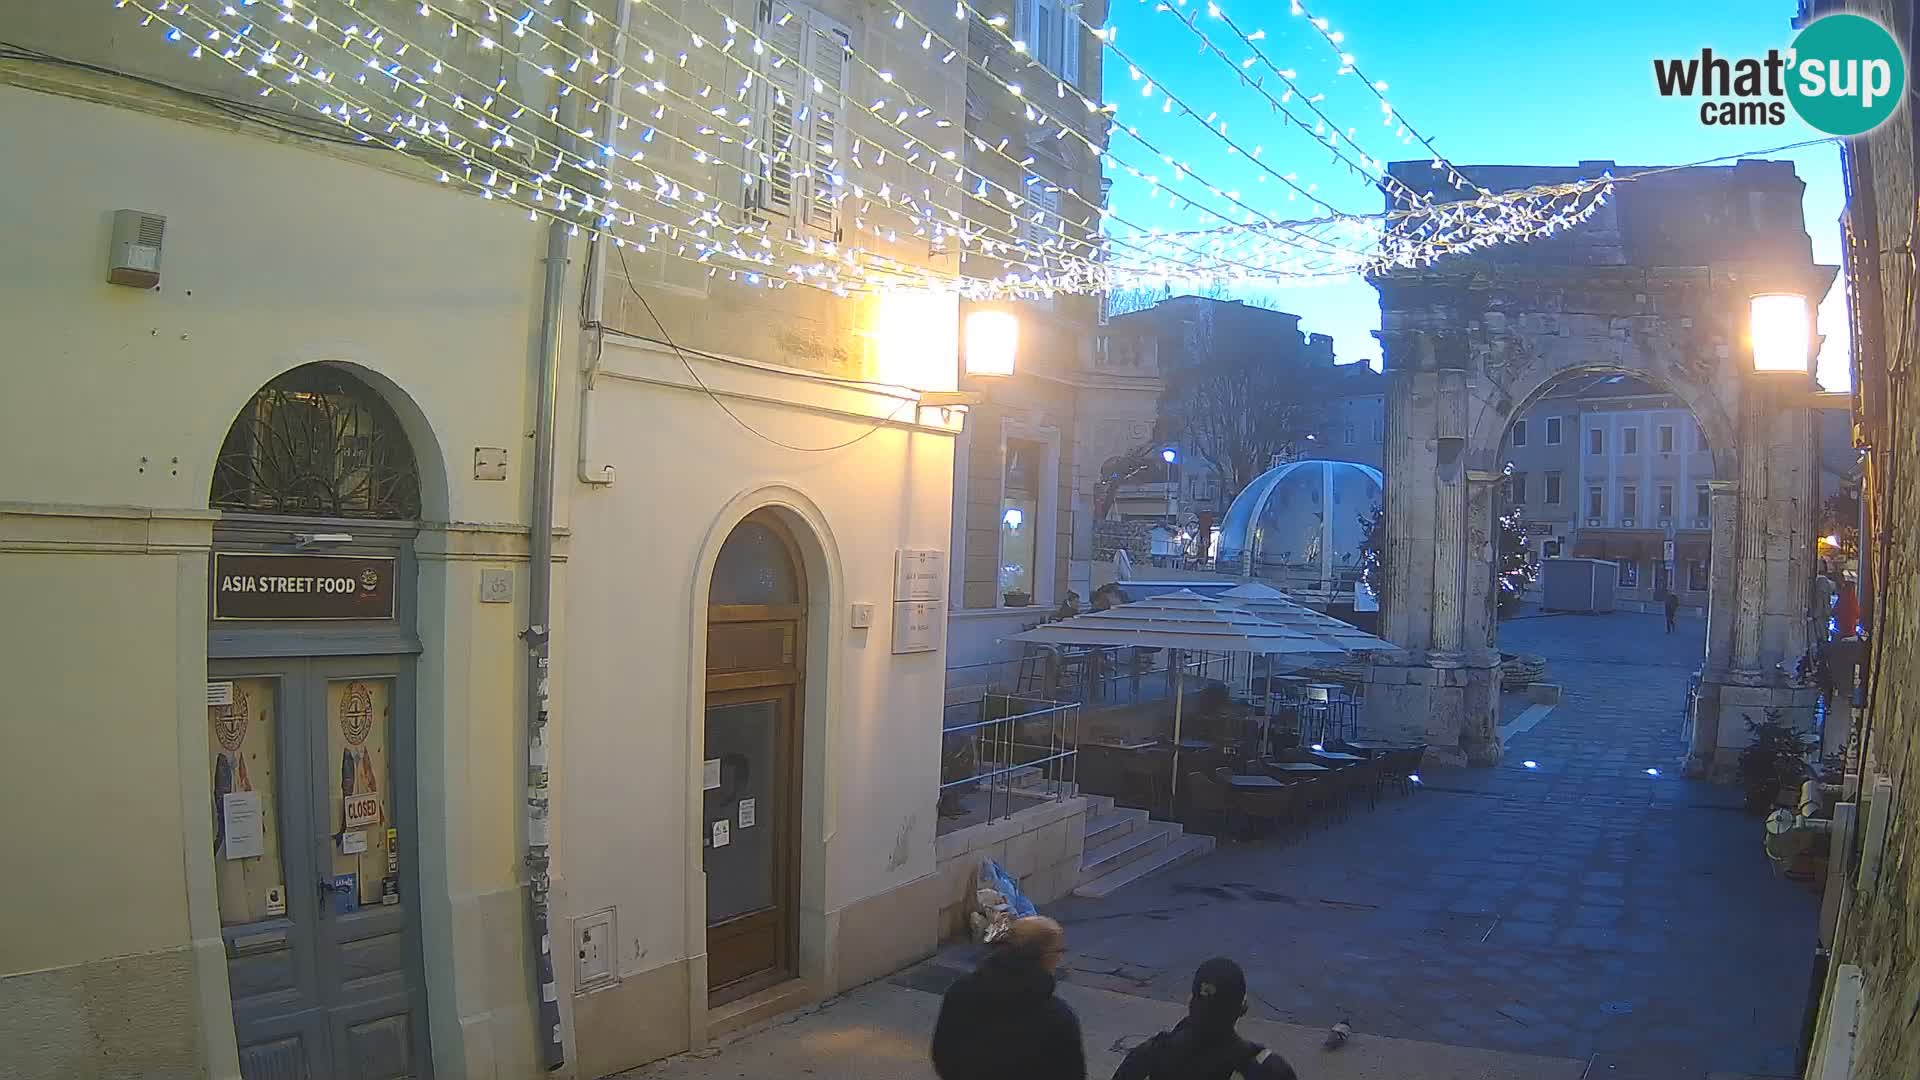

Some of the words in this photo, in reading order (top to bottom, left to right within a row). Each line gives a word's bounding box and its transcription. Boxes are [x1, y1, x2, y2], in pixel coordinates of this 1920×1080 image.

[222, 575, 257, 593] ASIA
[259, 576, 314, 593] STREET
[316, 577, 356, 594] FOOD
[348, 799, 377, 819] CLOSED
